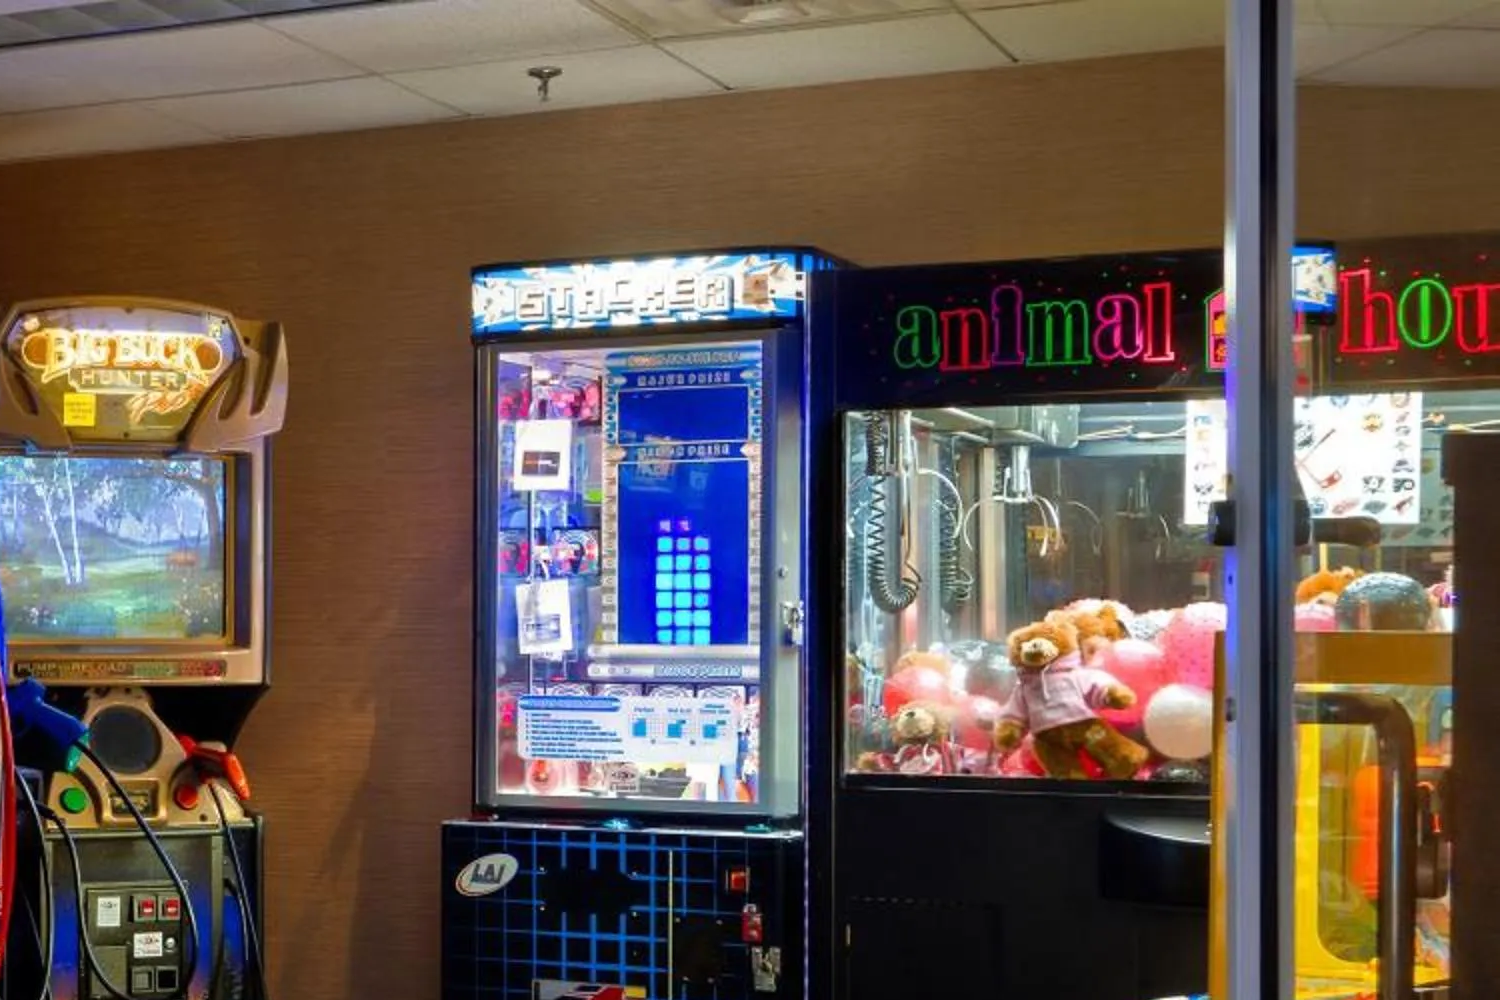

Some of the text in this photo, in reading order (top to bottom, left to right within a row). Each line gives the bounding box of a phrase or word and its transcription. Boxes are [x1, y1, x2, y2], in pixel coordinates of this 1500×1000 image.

[893, 282, 1175, 371] animal
[43, 328, 209, 384] BIG BUCK
[81, 370, 180, 388] HUNTER
